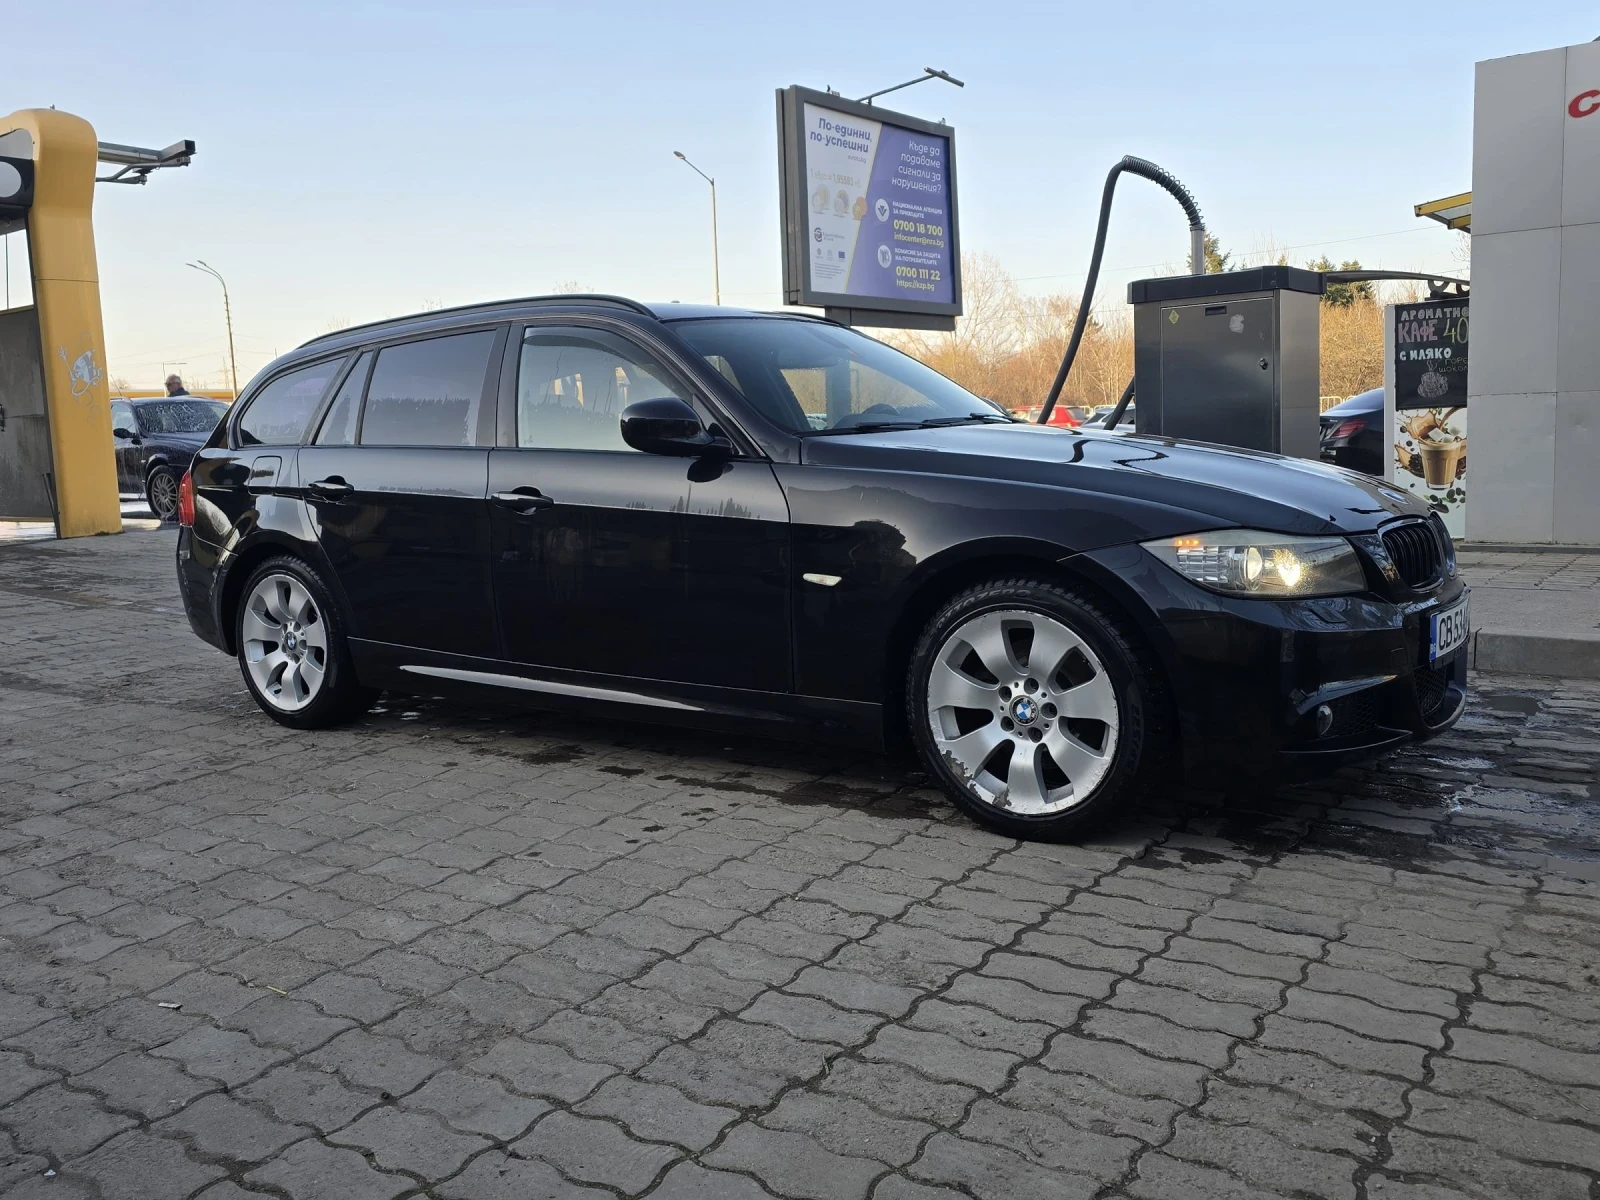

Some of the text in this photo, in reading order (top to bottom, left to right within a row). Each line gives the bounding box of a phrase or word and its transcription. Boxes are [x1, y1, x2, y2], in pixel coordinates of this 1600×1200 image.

[818, 117, 872, 142] По-единни,
[810, 131, 869, 153] по-успешни
[909, 140, 940, 156] Къде да
[901, 153, 941, 168] подаваме
[898, 165, 941, 182] сигнали за
[891, 176, 942, 193] нарушения?
[893, 219, 943, 237] 0700 18 700
[893, 232, 945, 248] infocenter@nra.bg
[895, 266, 941, 281] 0700 111 22
[1397, 319, 1438, 344] КАФЕ
[1399, 347, 1452, 361] С МЛЯКО
[1439, 614, 1453, 651] CB
